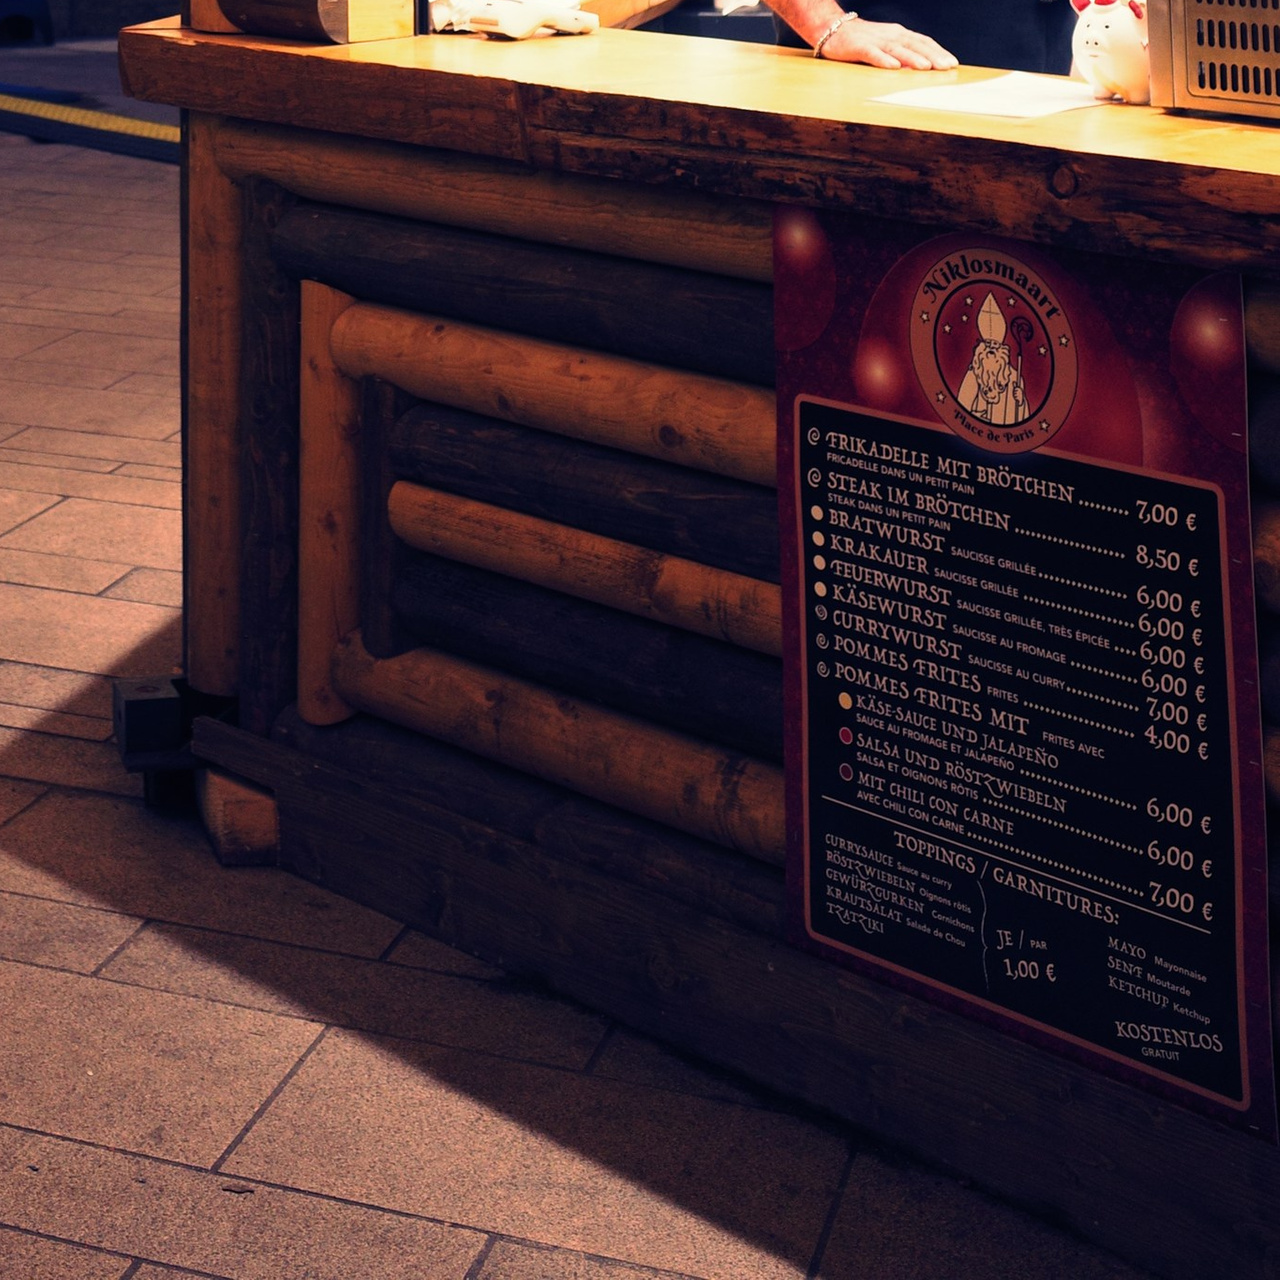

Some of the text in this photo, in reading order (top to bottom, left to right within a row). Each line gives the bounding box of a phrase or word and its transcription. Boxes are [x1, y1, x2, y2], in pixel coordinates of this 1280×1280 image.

[923, 255, 1060, 319] Niklosmaart
[954, 409, 1035, 443] Place de Paris
[826, 432, 1197, 532] FRIKADELLE MIT BRÖTCHEN 7,00 €
[827, 452, 975, 495] FRICADELLE DANS UN PETIT PAIN
[827, 472, 1199, 576] STEAK IM BRÖTCHEN 8,50 €
[828, 493, 951, 531] STEAK DANS UN PETIT PAIN
[829, 508, 1201, 618] BRATWURST SAUCISSE GRILLÉE 6,00 €
[830, 534, 1203, 646] KRAKAUER SAUCISSE GRILLÉE 6,00 €
[830, 559, 1204, 674] FEUERWURST SAUCISSE GRILLÉE, TRÈS ÉPICÉE 6,00 €
[833, 582, 1206, 703] KÄSEWURST SAUCISSE AU FROMAGE 6,00 €
[833, 610, 1207, 732] CURRYWURST SAUCISSE AU CURRY 7,00 €
[834, 635, 1209, 760] POMMES FRITES FRITES 4,00 €
[835, 662, 1105, 759] POMMES FRITES MIT FRITES AVEC
[856, 694, 1059, 769] KÄSE-SAUCE UND JALAPEÑO
[856, 713, 1211, 835] SAUCE AU FROMAGE ET JALAPEÑO 6,00 €
[857, 733, 1067, 814] SALSA UND RÖSTZWIEBELN
[858, 771, 1014, 836] MIT CHILI CON CARNE
[856, 752, 1212, 878] SALSA ET OIGNONS RÔTIS 6,00 €
[825, 833, 952, 891] CURRYSAUCE Sauce au curry
[826, 850, 916, 893] RÖSTZWIEBELN
[920, 888, 951, 906] Oignons
[857, 791, 1213, 921] AVEC CHILI CON CARNE 7,00 €
[893, 831, 1120, 925] TOPPINGS / GARNITURES:
[826, 868, 975, 933] GEWÜRZGURKEN Cornichons
[826, 885, 966, 947] KRAUTSALAT Salade de Chou
[826, 902, 884, 934] TZATZIKI
[996, 929, 1013, 950] JE
[1030, 940, 1048, 950] PAR
[1003, 958, 1057, 982] 1,00 €
[1108, 936, 1208, 983] MAYO Mayonnaise
[1108, 955, 1191, 997] SENF Moutarde
[1108, 975, 1211, 1025] KETCHUP Ketchup
[1115, 1021, 1223, 1053] KOSTENLOS
[1141, 1046, 1180, 1061] GRATUIT
